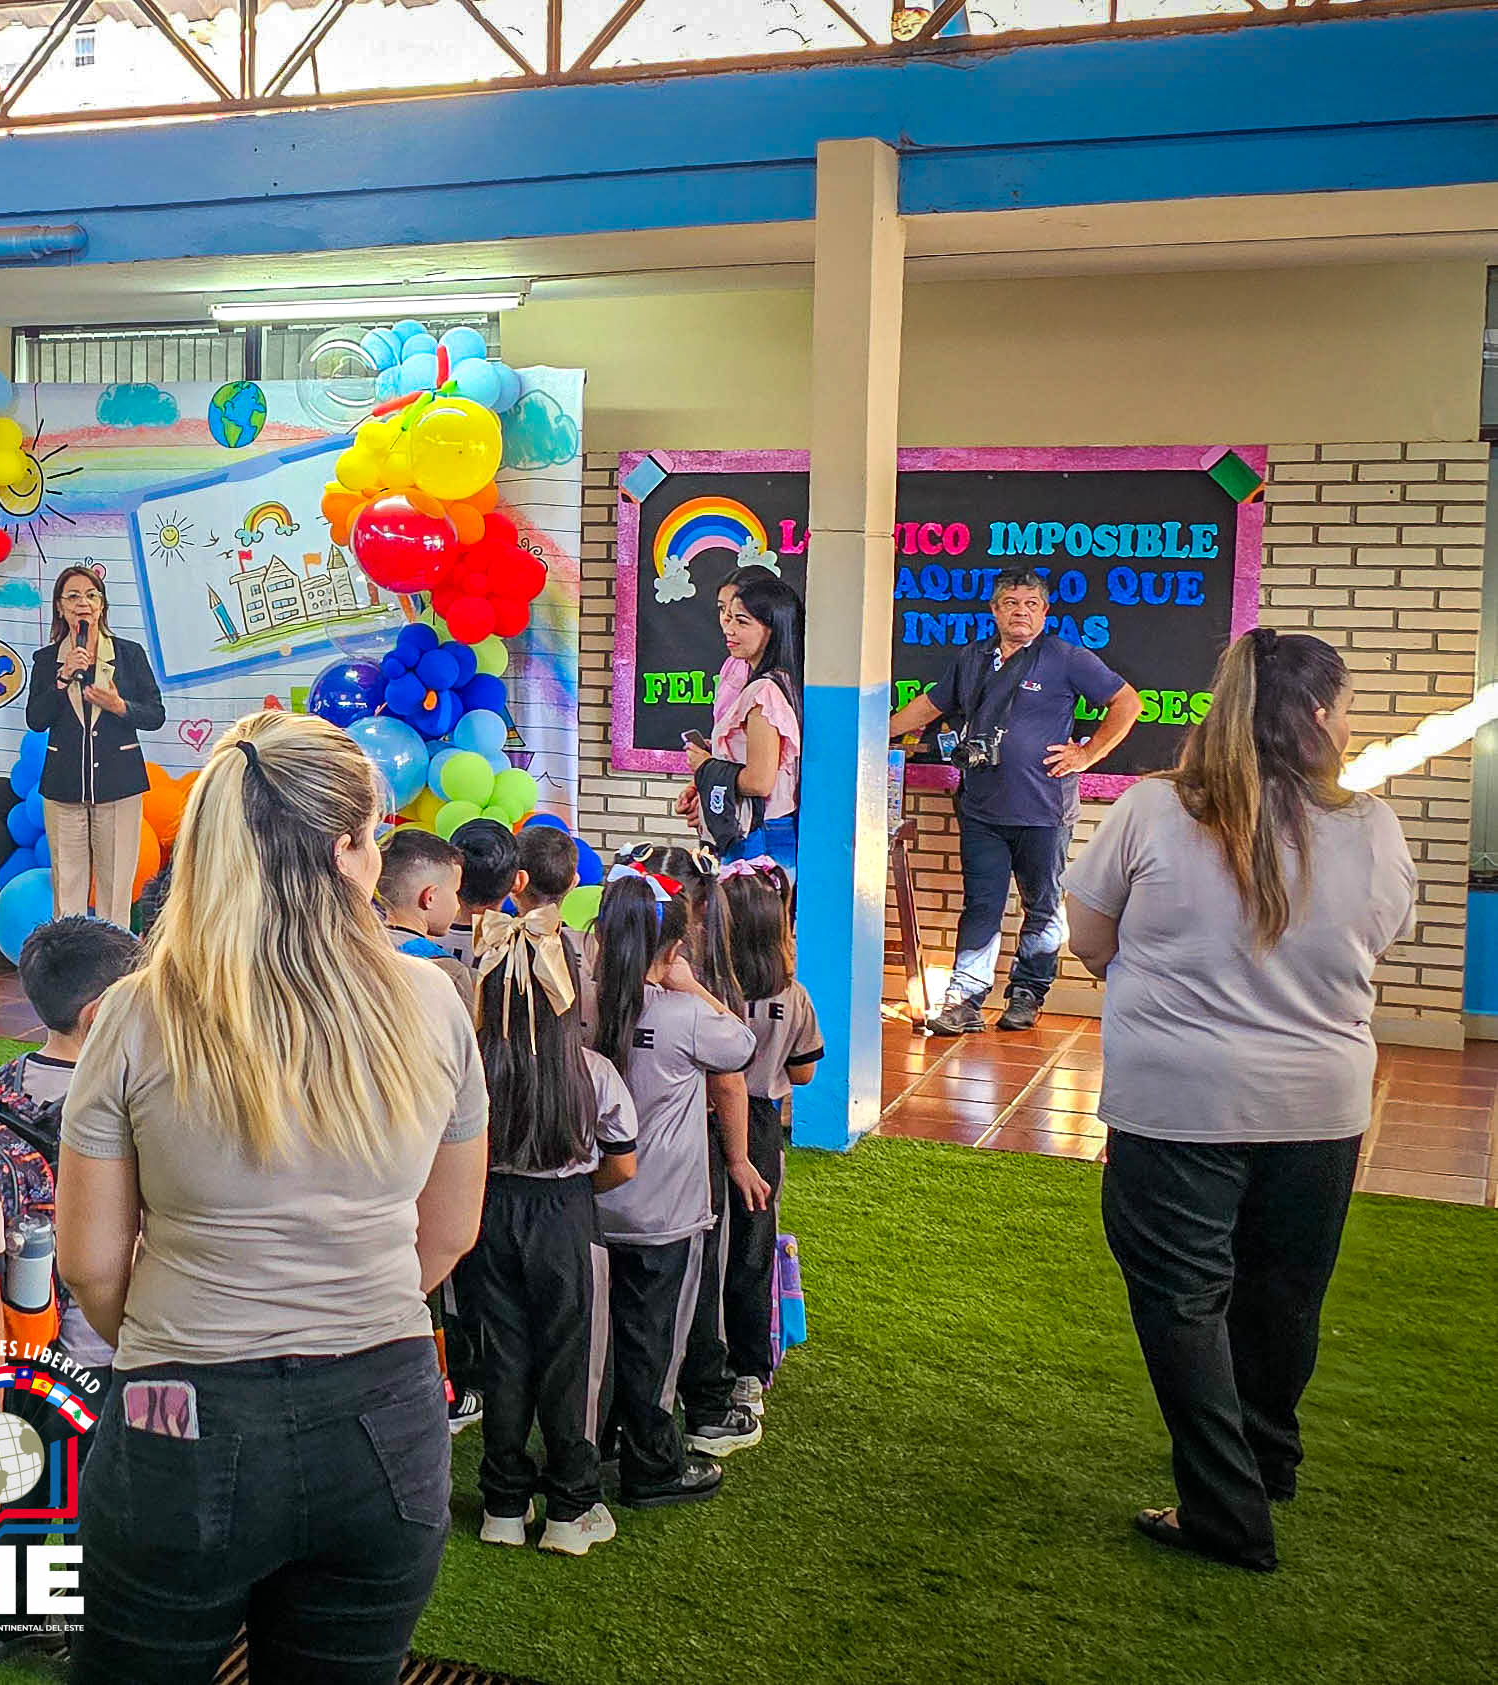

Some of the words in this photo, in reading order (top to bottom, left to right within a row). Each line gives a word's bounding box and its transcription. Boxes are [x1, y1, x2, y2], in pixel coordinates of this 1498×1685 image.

[779, 519, 810, 554] L
[987, 520, 1219, 560] IMPOSIBLE
[1106, 564, 1205, 607] QUE
